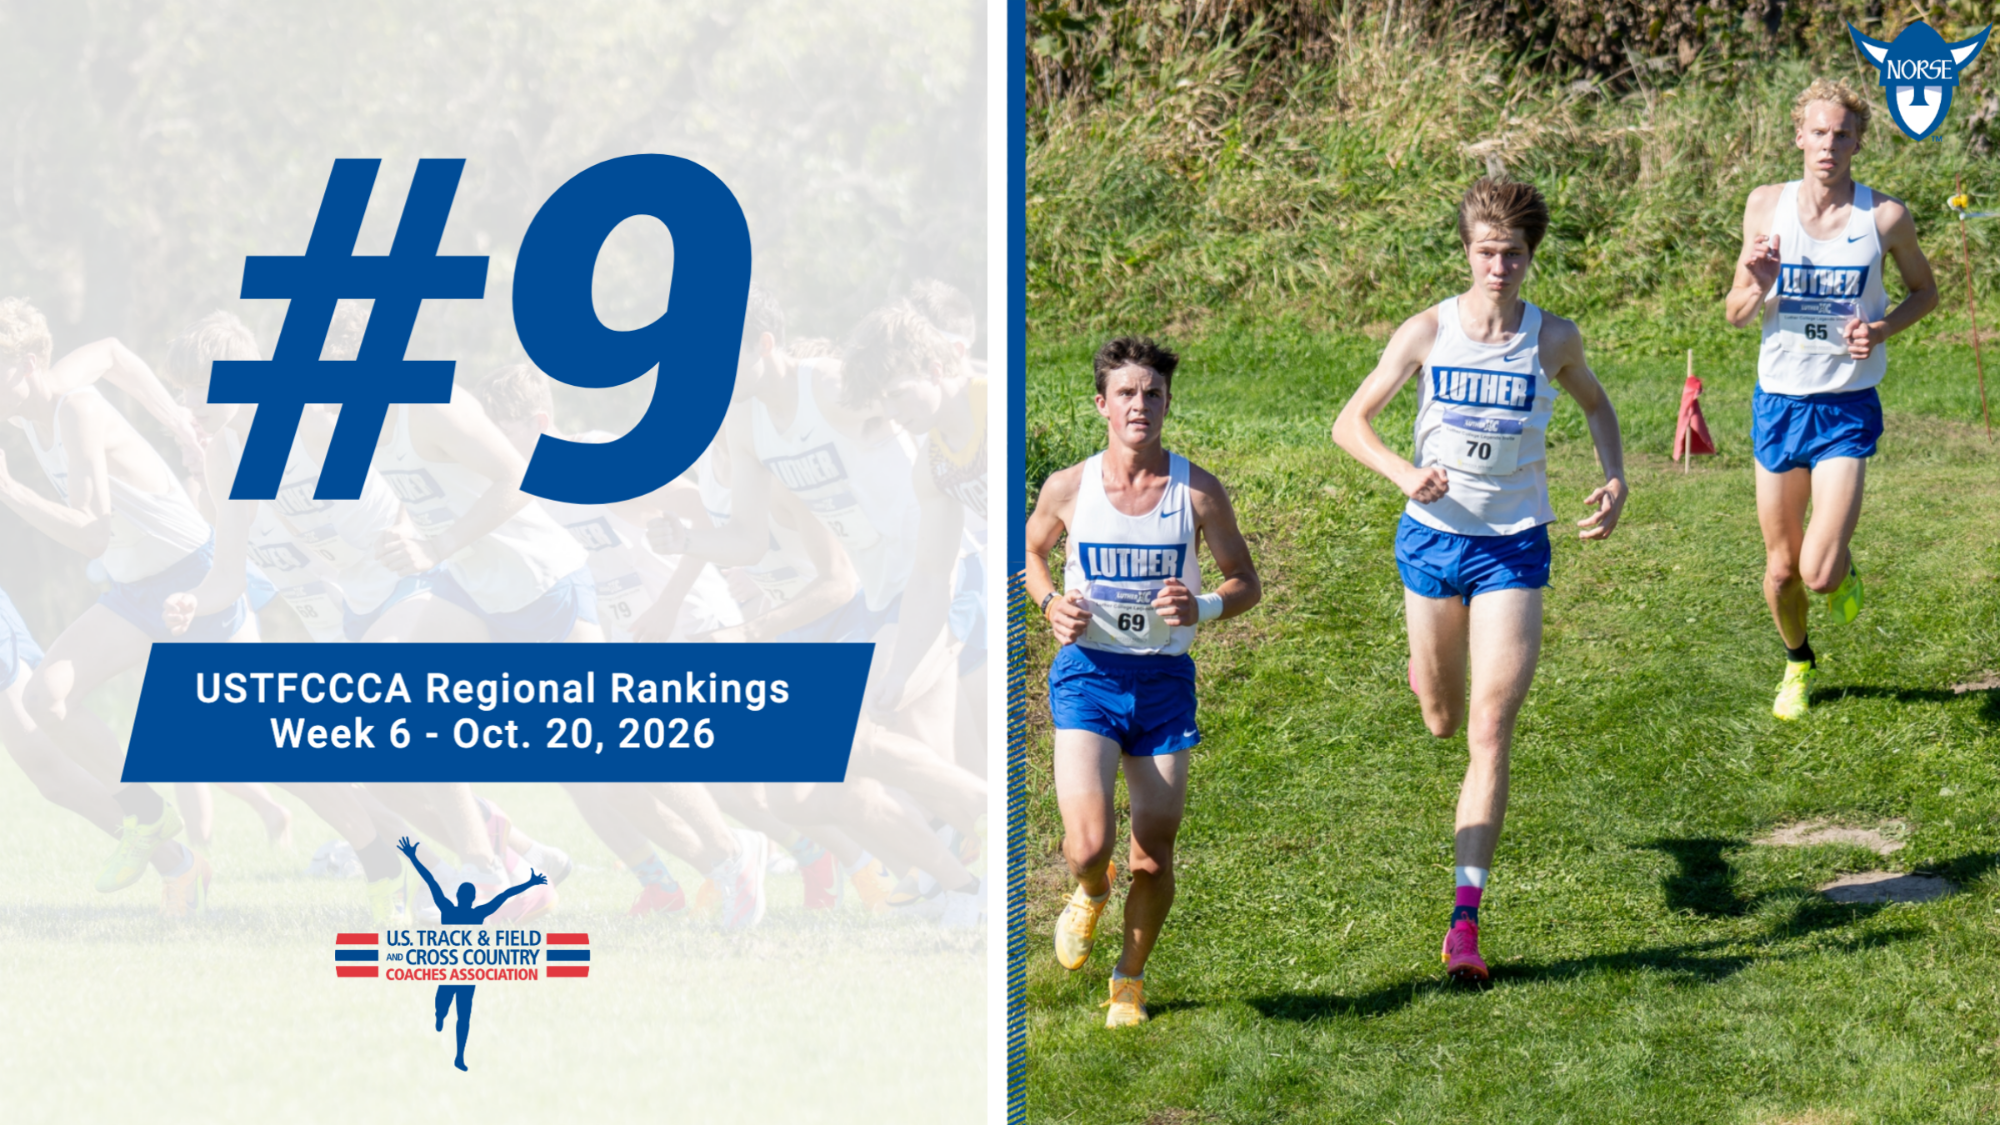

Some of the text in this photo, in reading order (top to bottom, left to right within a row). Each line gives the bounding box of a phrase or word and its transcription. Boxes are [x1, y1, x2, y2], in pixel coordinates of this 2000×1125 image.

[1782, 267, 1861, 296] LUTHER
[1804, 323, 1828, 341] 65
[1438, 370, 1529, 408] LUTHER
[1465, 440, 1492, 461] 70
[1087, 546, 1179, 578] LUTHER
[296, 604, 319, 618] 68
[608, 601, 632, 621] 79
[1118, 612, 1146, 632] 69
